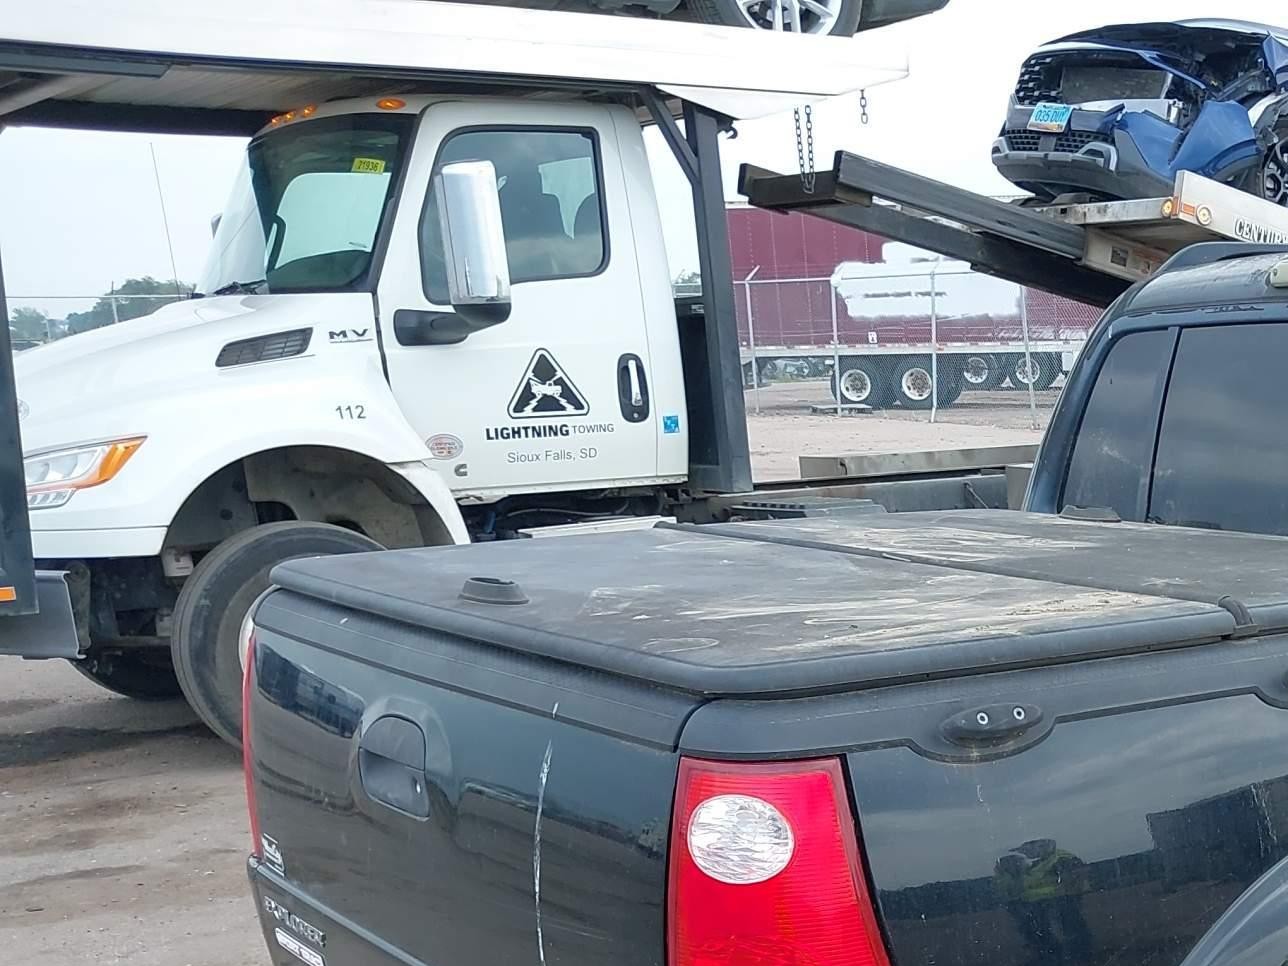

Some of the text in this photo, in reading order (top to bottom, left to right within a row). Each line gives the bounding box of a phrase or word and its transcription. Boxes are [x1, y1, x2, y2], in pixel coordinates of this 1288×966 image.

[335, 404, 367, 420] 112
[485, 423, 615, 440] LIGHTNING TOWING
[507, 447, 598, 464] Sioux Falls, SD
